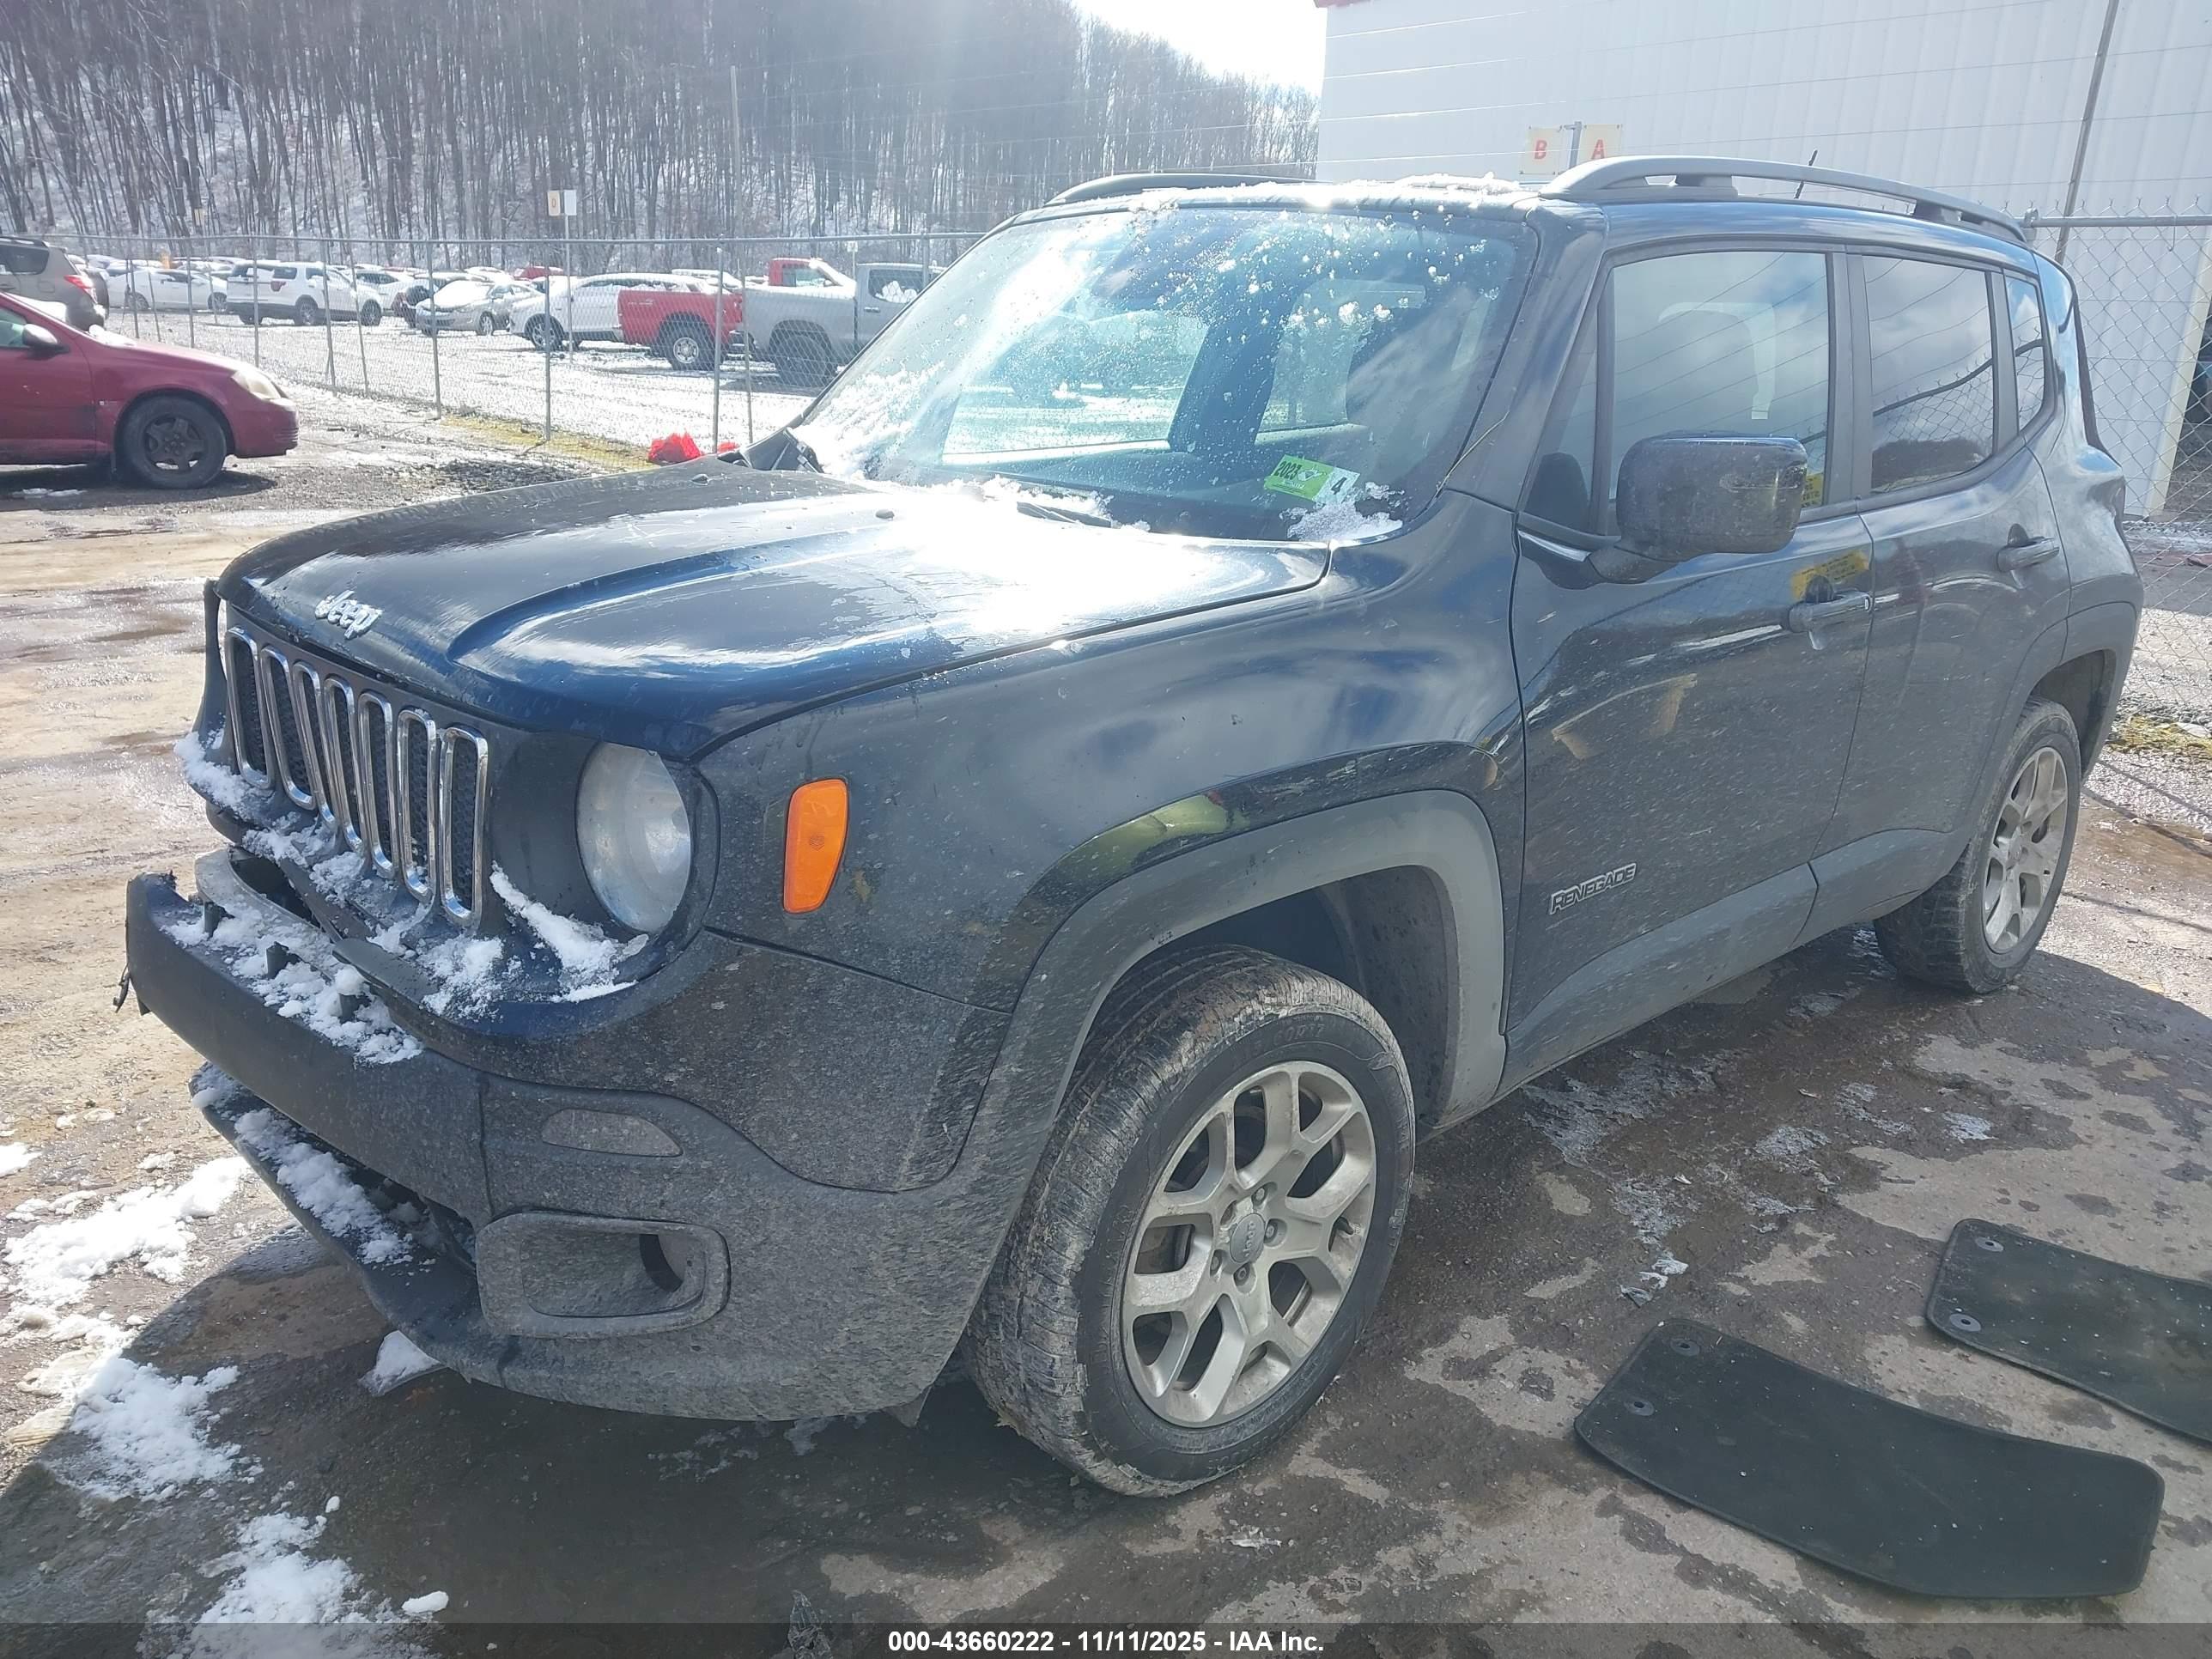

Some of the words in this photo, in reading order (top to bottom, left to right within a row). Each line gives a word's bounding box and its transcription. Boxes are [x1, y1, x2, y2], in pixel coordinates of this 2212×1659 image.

[1534, 140, 1547, 160] B
[1591, 139, 1605, 160] A
[1331, 477, 1347, 495] 4
[314, 590, 383, 639] Jeep
[1549, 862, 1637, 915] RENEGADE
